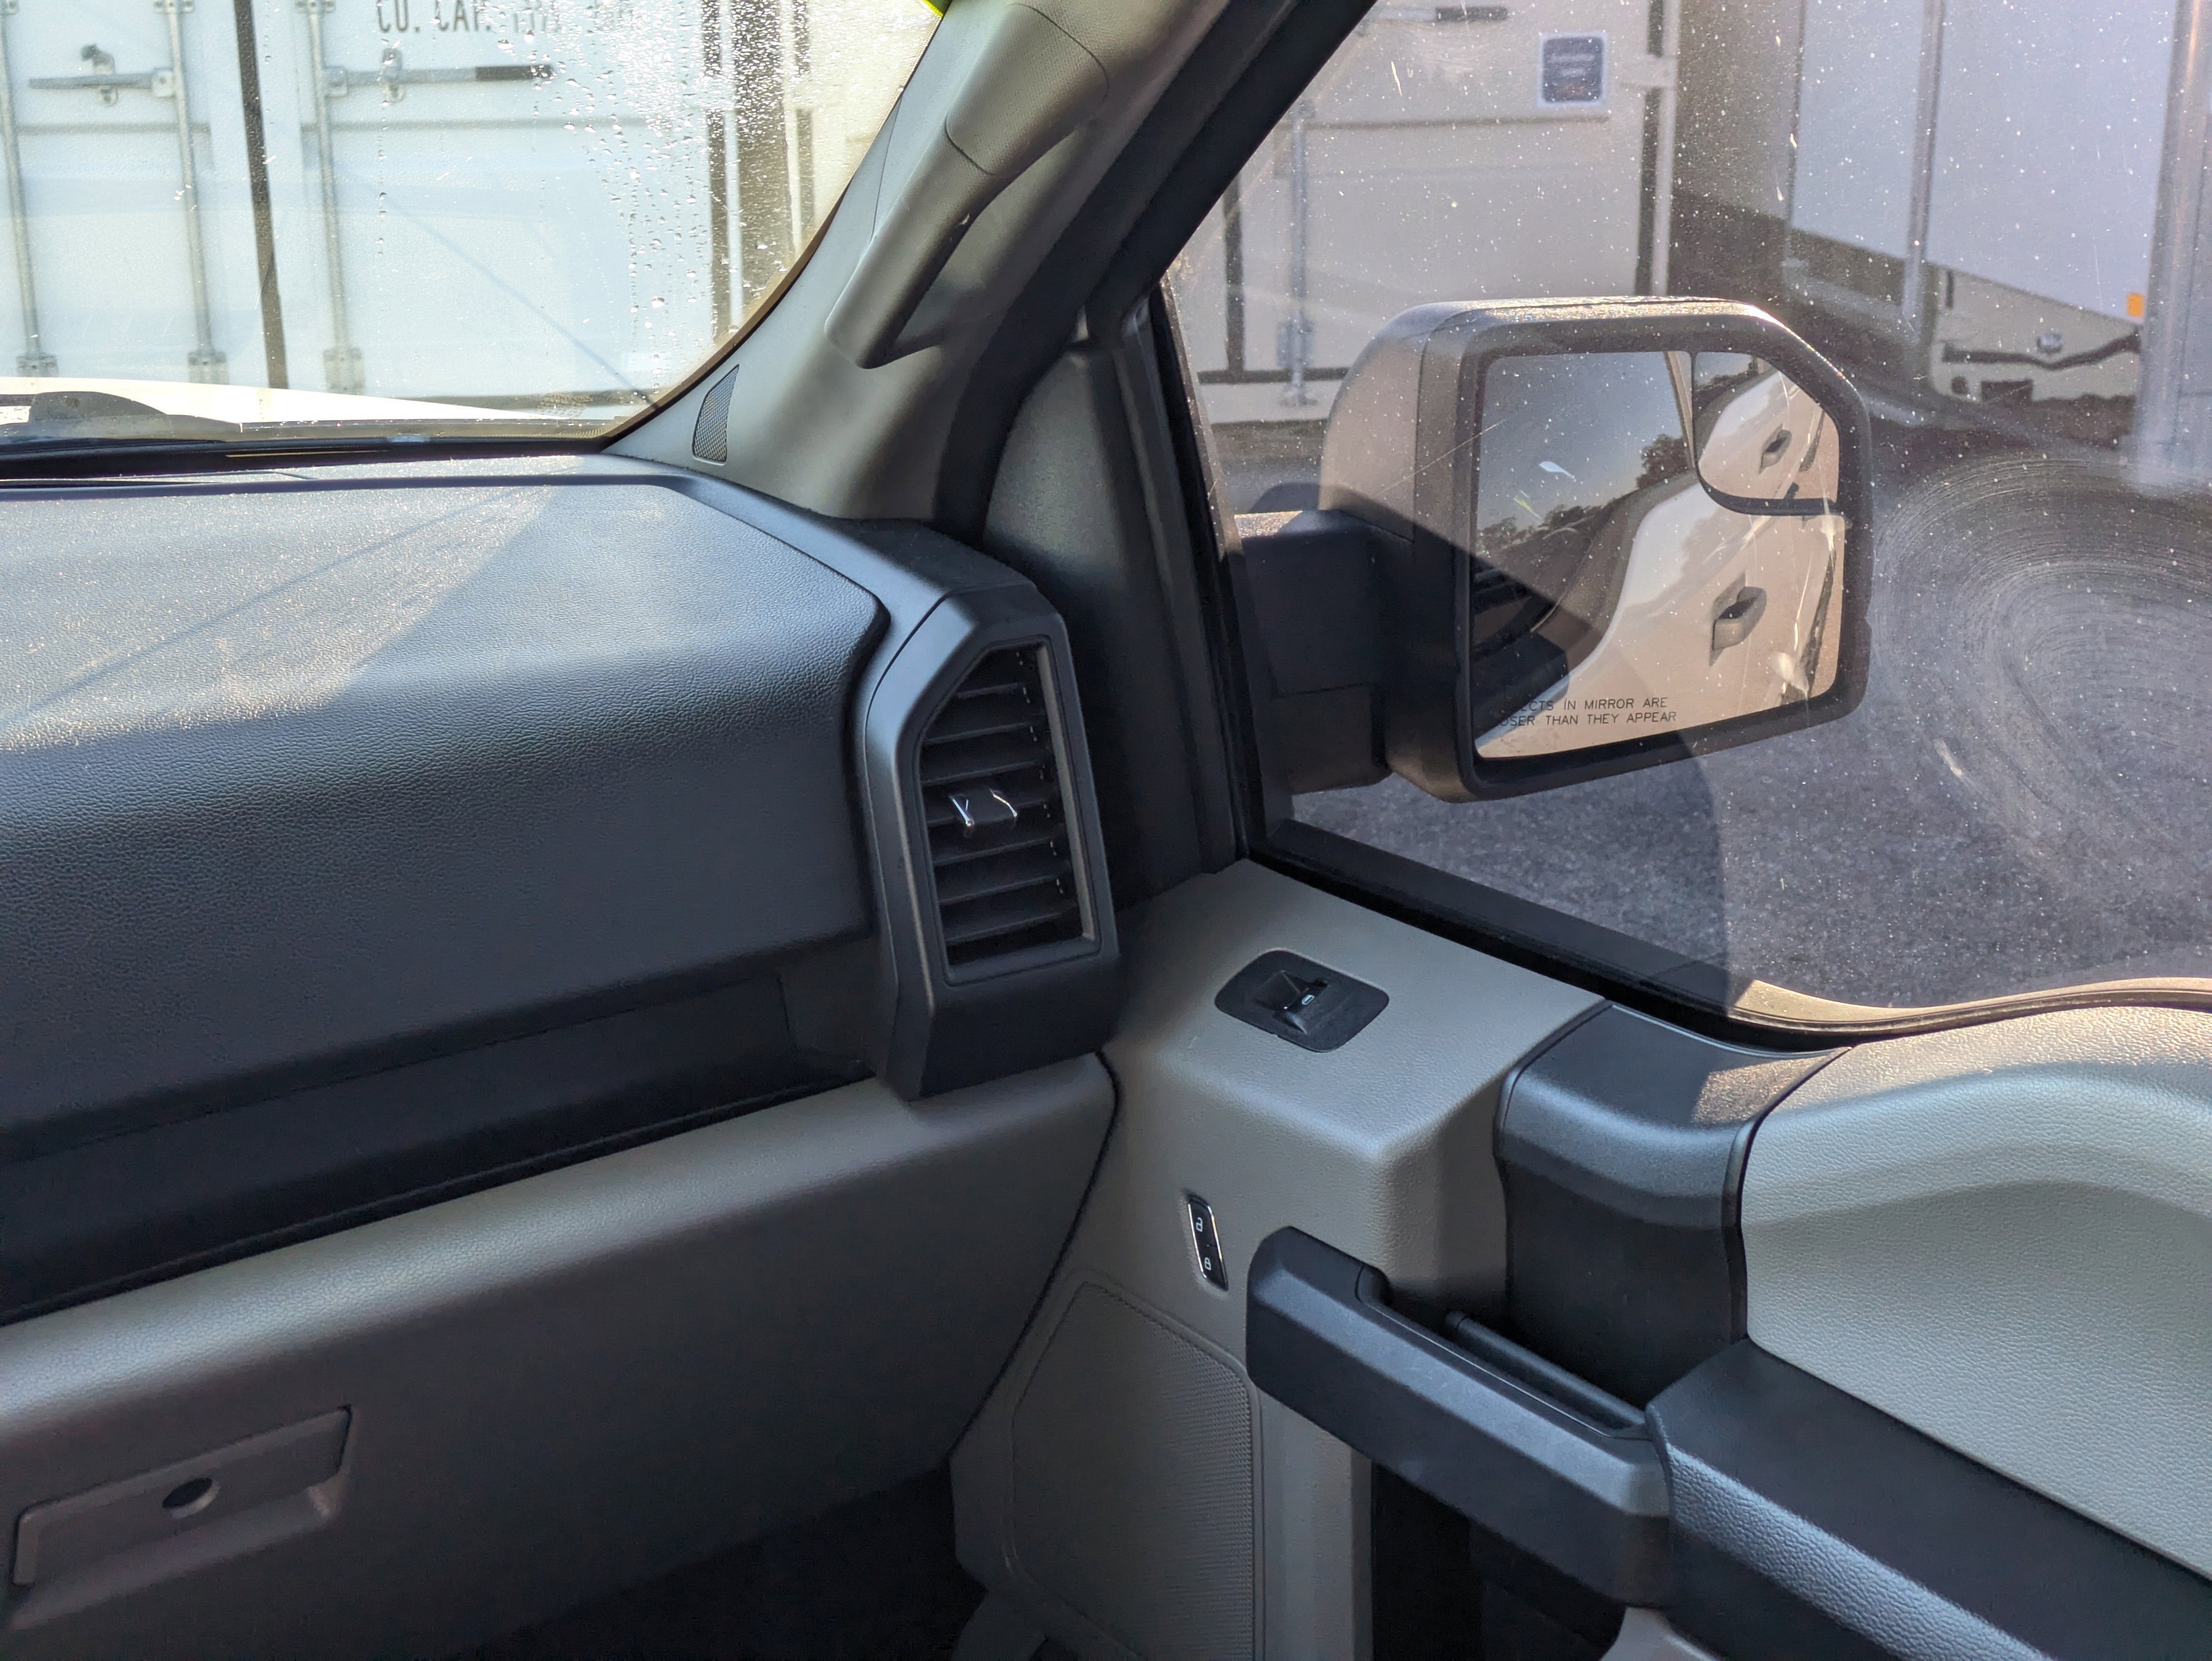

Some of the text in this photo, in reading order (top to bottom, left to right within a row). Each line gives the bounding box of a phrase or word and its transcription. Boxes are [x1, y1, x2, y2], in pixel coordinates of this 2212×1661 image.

[1563, 699, 1576, 710] IN
[1584, 698, 1634, 710] MIRROR
[1643, 698, 1668, 708] ARE
[1546, 715, 1578, 725] THAN
[1587, 713, 1619, 724] THEY
[1626, 711, 1677, 722] APPEAR
